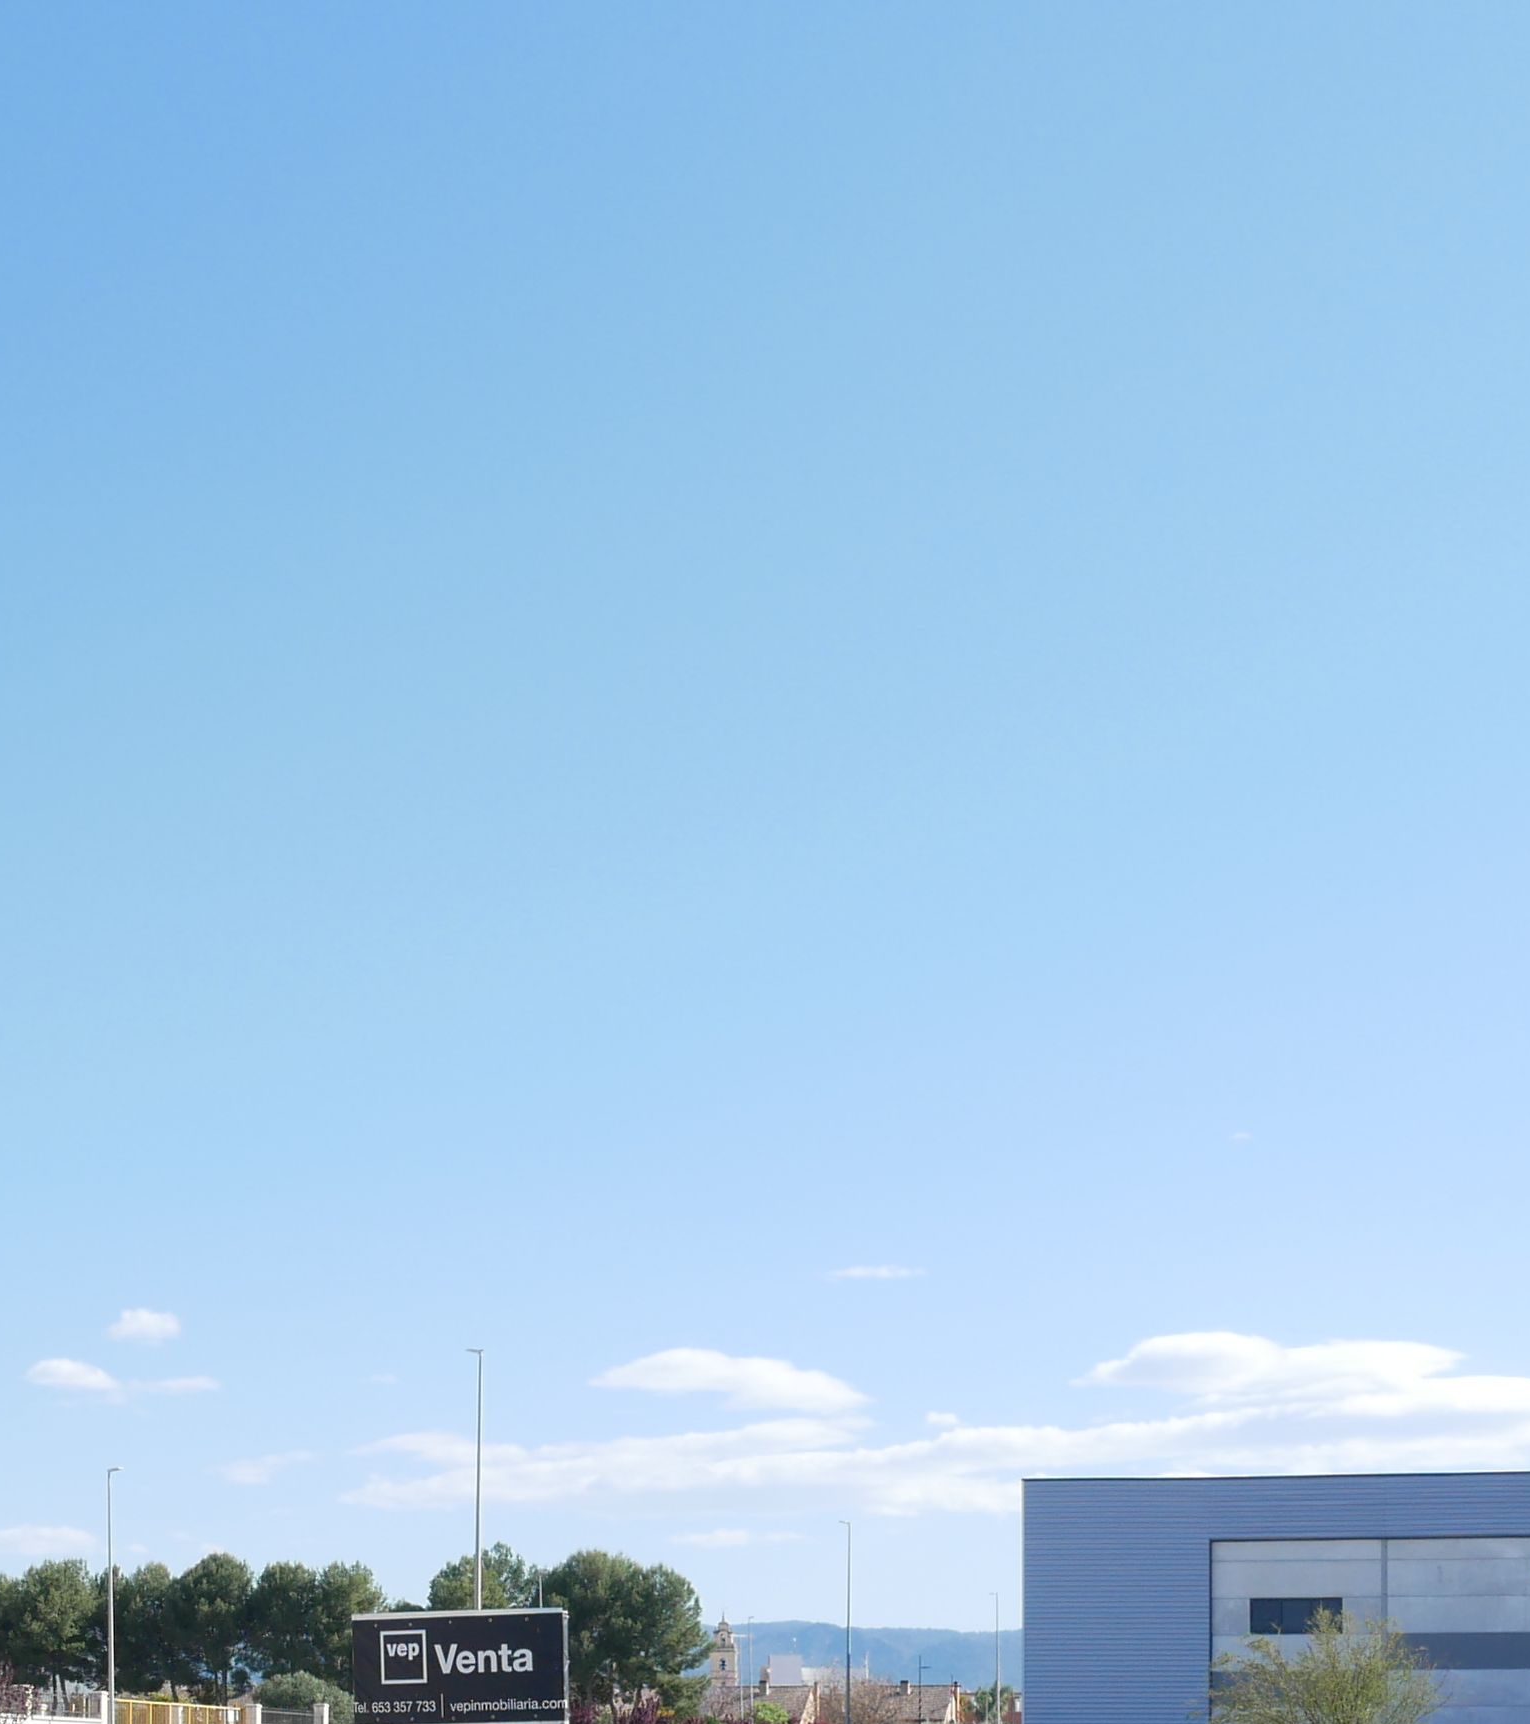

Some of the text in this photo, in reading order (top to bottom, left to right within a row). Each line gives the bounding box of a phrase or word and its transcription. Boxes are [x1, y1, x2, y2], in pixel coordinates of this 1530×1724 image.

[386, 1641, 419, 1661] vep
[434, 1644, 534, 1674] Venta
[354, 1700, 436, 1714] Tel. 653 357 733
[450, 1698, 568, 1713] vepinmobiliaria.com
